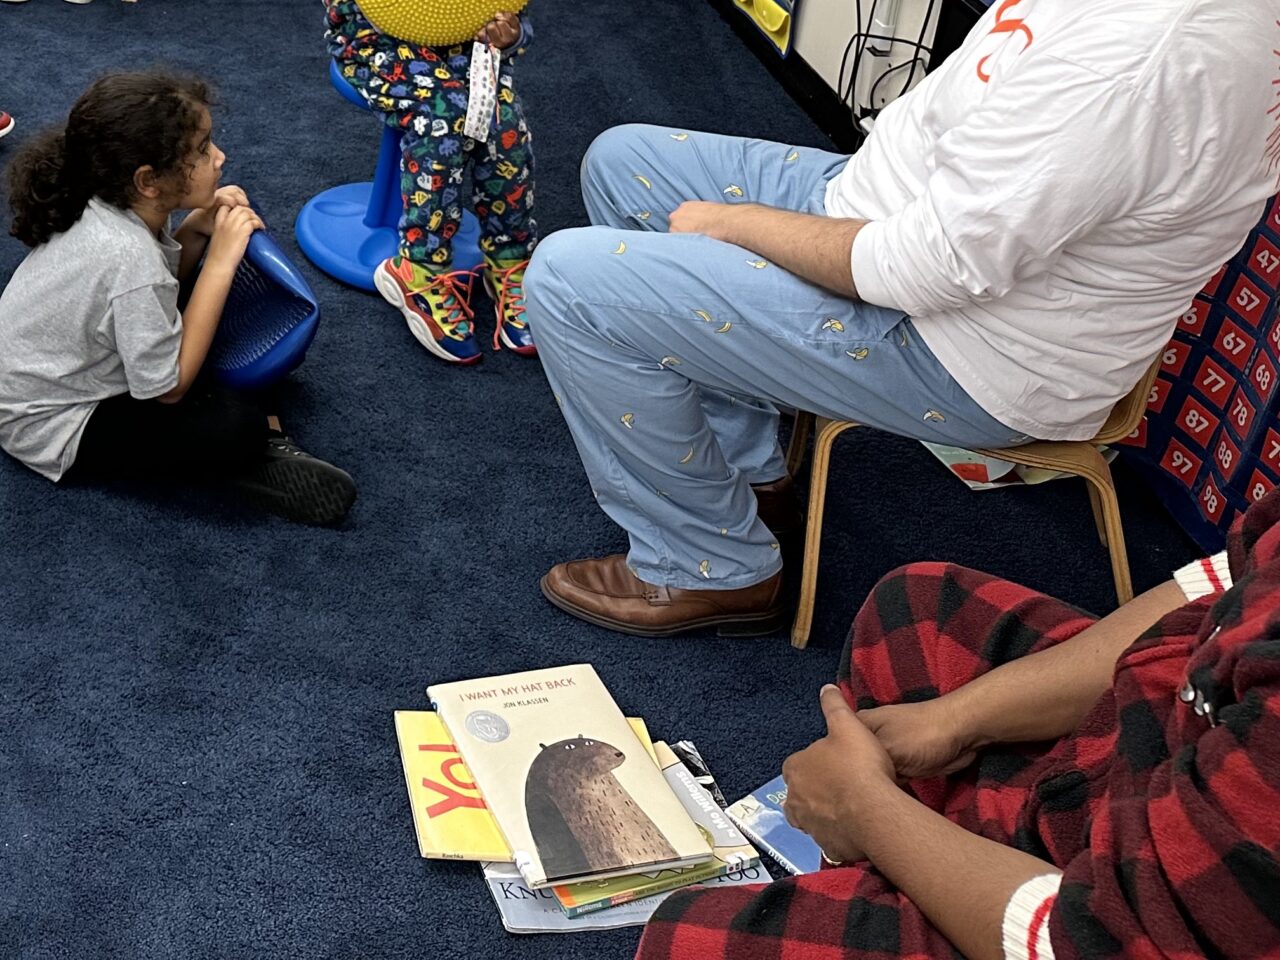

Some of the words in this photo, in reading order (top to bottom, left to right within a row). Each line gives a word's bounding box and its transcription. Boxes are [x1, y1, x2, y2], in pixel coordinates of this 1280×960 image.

[1256, 249, 1280, 273] 47
[1236, 286, 1261, 312] 57
[1222, 332, 1246, 356] 67
[1202, 367, 1226, 393] 77
[1255, 364, 1271, 391] 68
[1185, 409, 1209, 433] 87
[1232, 398, 1248, 426] 78
[1171, 450, 1193, 474] 97
[1218, 440, 1233, 469] 88
[1203, 485, 1218, 514] 98
[465, 690, 499, 702] WANT
[501, 685, 519, 697] MY
[521, 682, 544, 694] HAT
[546, 677, 577, 690] BACK
[503, 701, 516, 709] JON
[517, 696, 550, 707] KLASSEN
[676, 771, 715, 813] Willems
[710, 812, 728, 830] Mo
